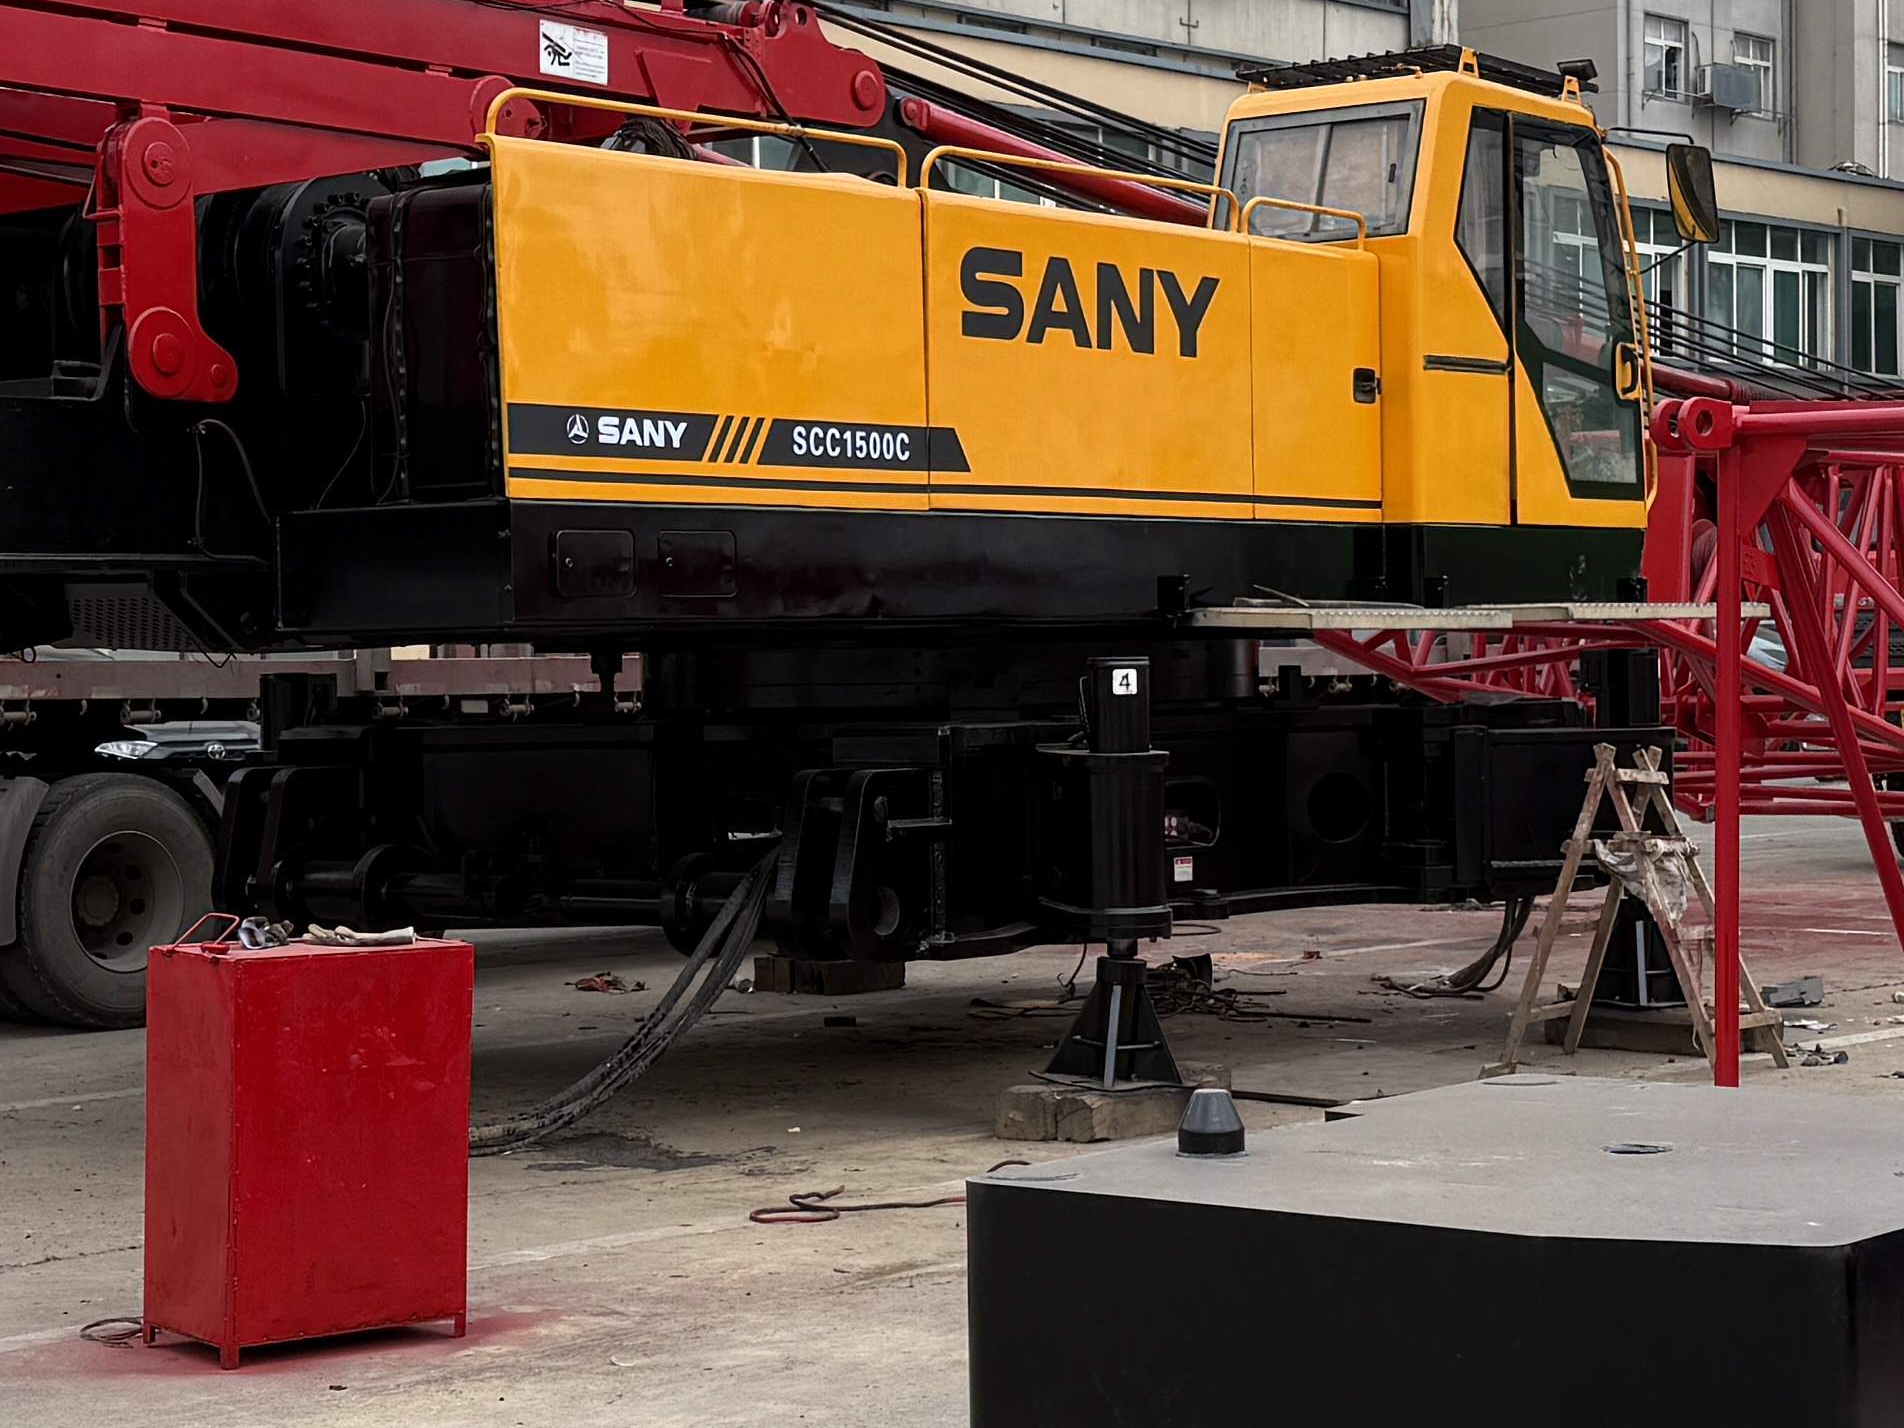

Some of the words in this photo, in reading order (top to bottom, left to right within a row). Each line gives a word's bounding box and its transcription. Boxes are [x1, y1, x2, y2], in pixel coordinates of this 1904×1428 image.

[960, 246, 1220, 358] SANY
[597, 416, 687, 449] SANY
[792, 425, 911, 462] SCC1500C
[1119, 672, 1131, 691] 4
